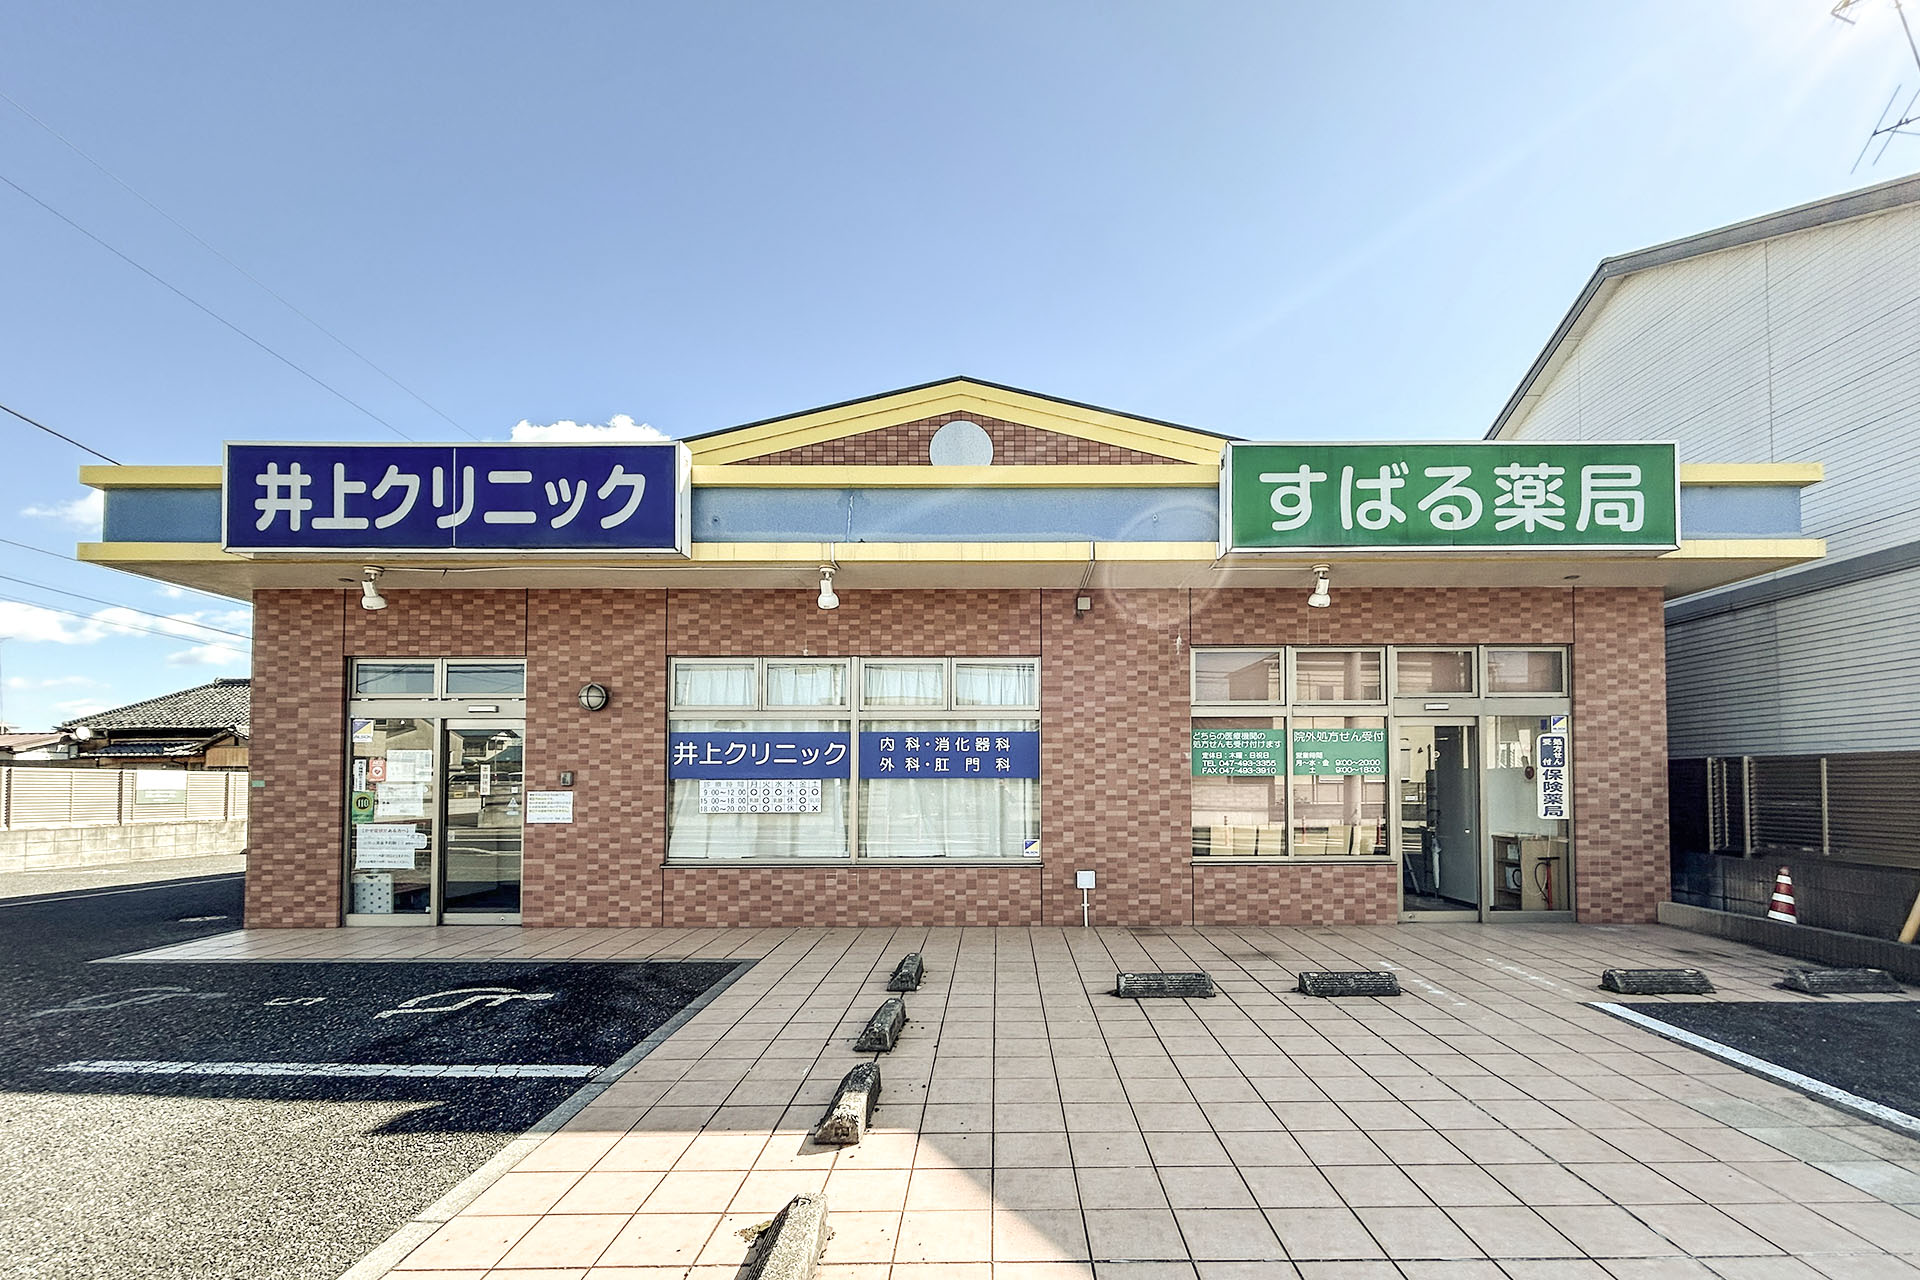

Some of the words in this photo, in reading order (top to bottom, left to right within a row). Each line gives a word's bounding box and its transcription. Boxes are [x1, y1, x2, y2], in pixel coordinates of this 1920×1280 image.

[254, 462, 647, 532] 井上クリニック
[1259, 462, 1645, 532] すばる薬局
[1192, 732, 1266, 740] どちらの医療機関の
[1192, 740, 1281, 749] 処方せんも受け付けます
[1293, 731, 1385, 742] 院外処方せん受付
[673, 741, 847, 766] 井上クリニック
[1542, 769, 1564, 817] 保険薬局
